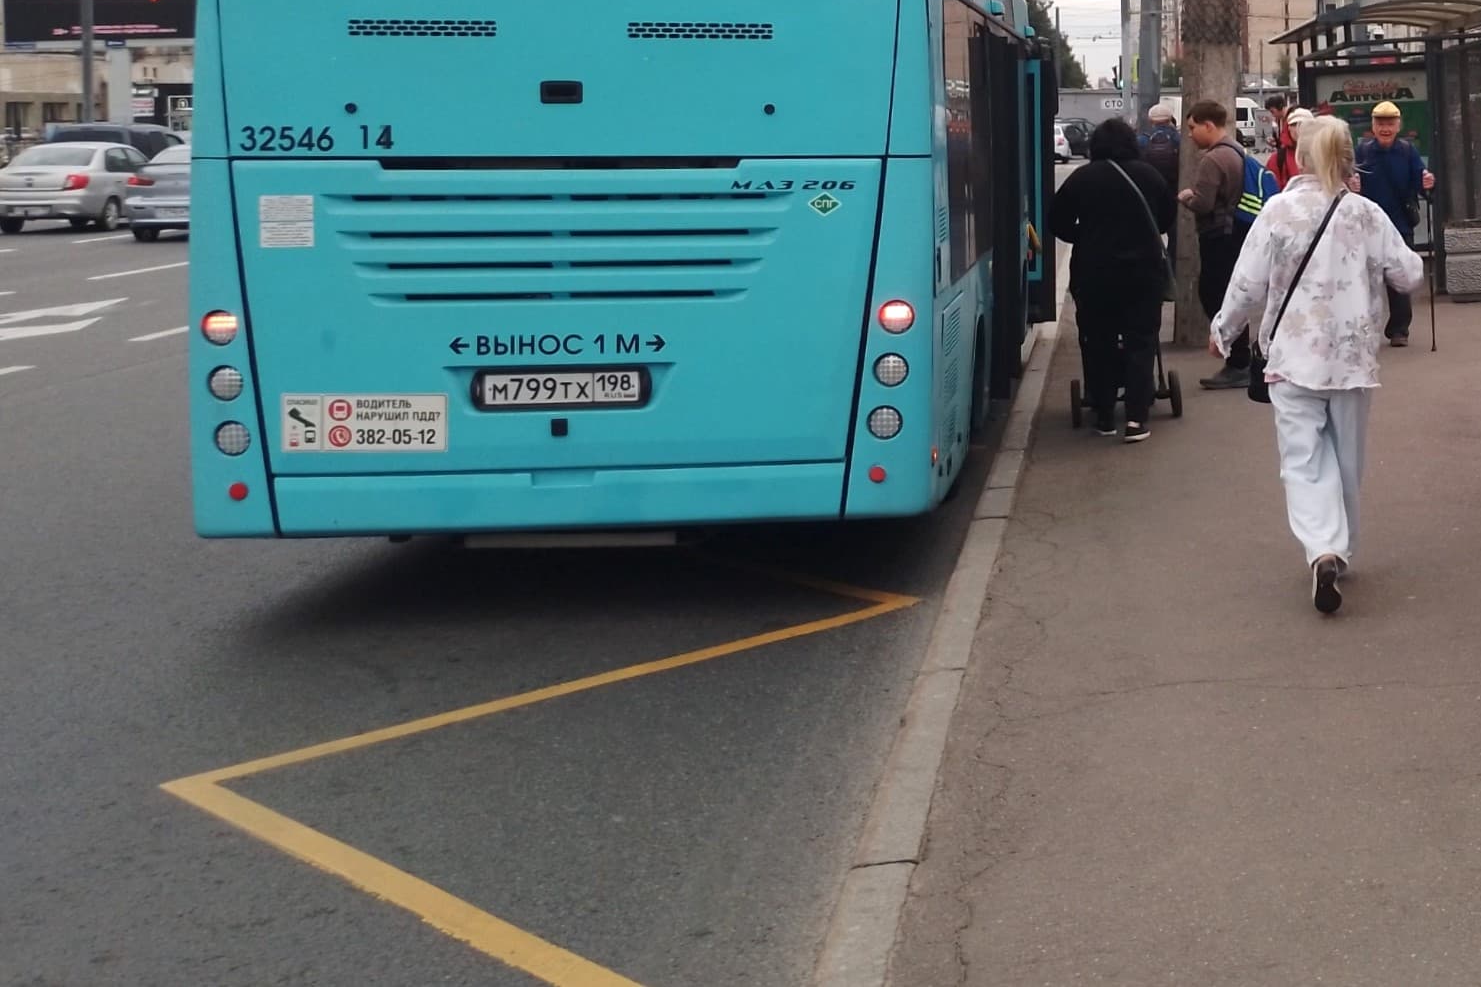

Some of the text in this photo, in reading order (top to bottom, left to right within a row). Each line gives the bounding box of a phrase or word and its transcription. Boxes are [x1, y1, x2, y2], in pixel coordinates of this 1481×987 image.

[1104, 100, 1123, 109] СТО
[240, 124, 395, 152] 32546 14
[731, 180, 857, 191] МАЗ 206
[476, 333, 640, 356] ВЫНОС 1 М
[596, 374, 632, 392] 198
[356, 399, 412, 410] ВОДИТЕЛЬ
[356, 411, 441, 422] НАРУШИЛ ПДД?
[356, 428, 436, 445] 382-05-12
